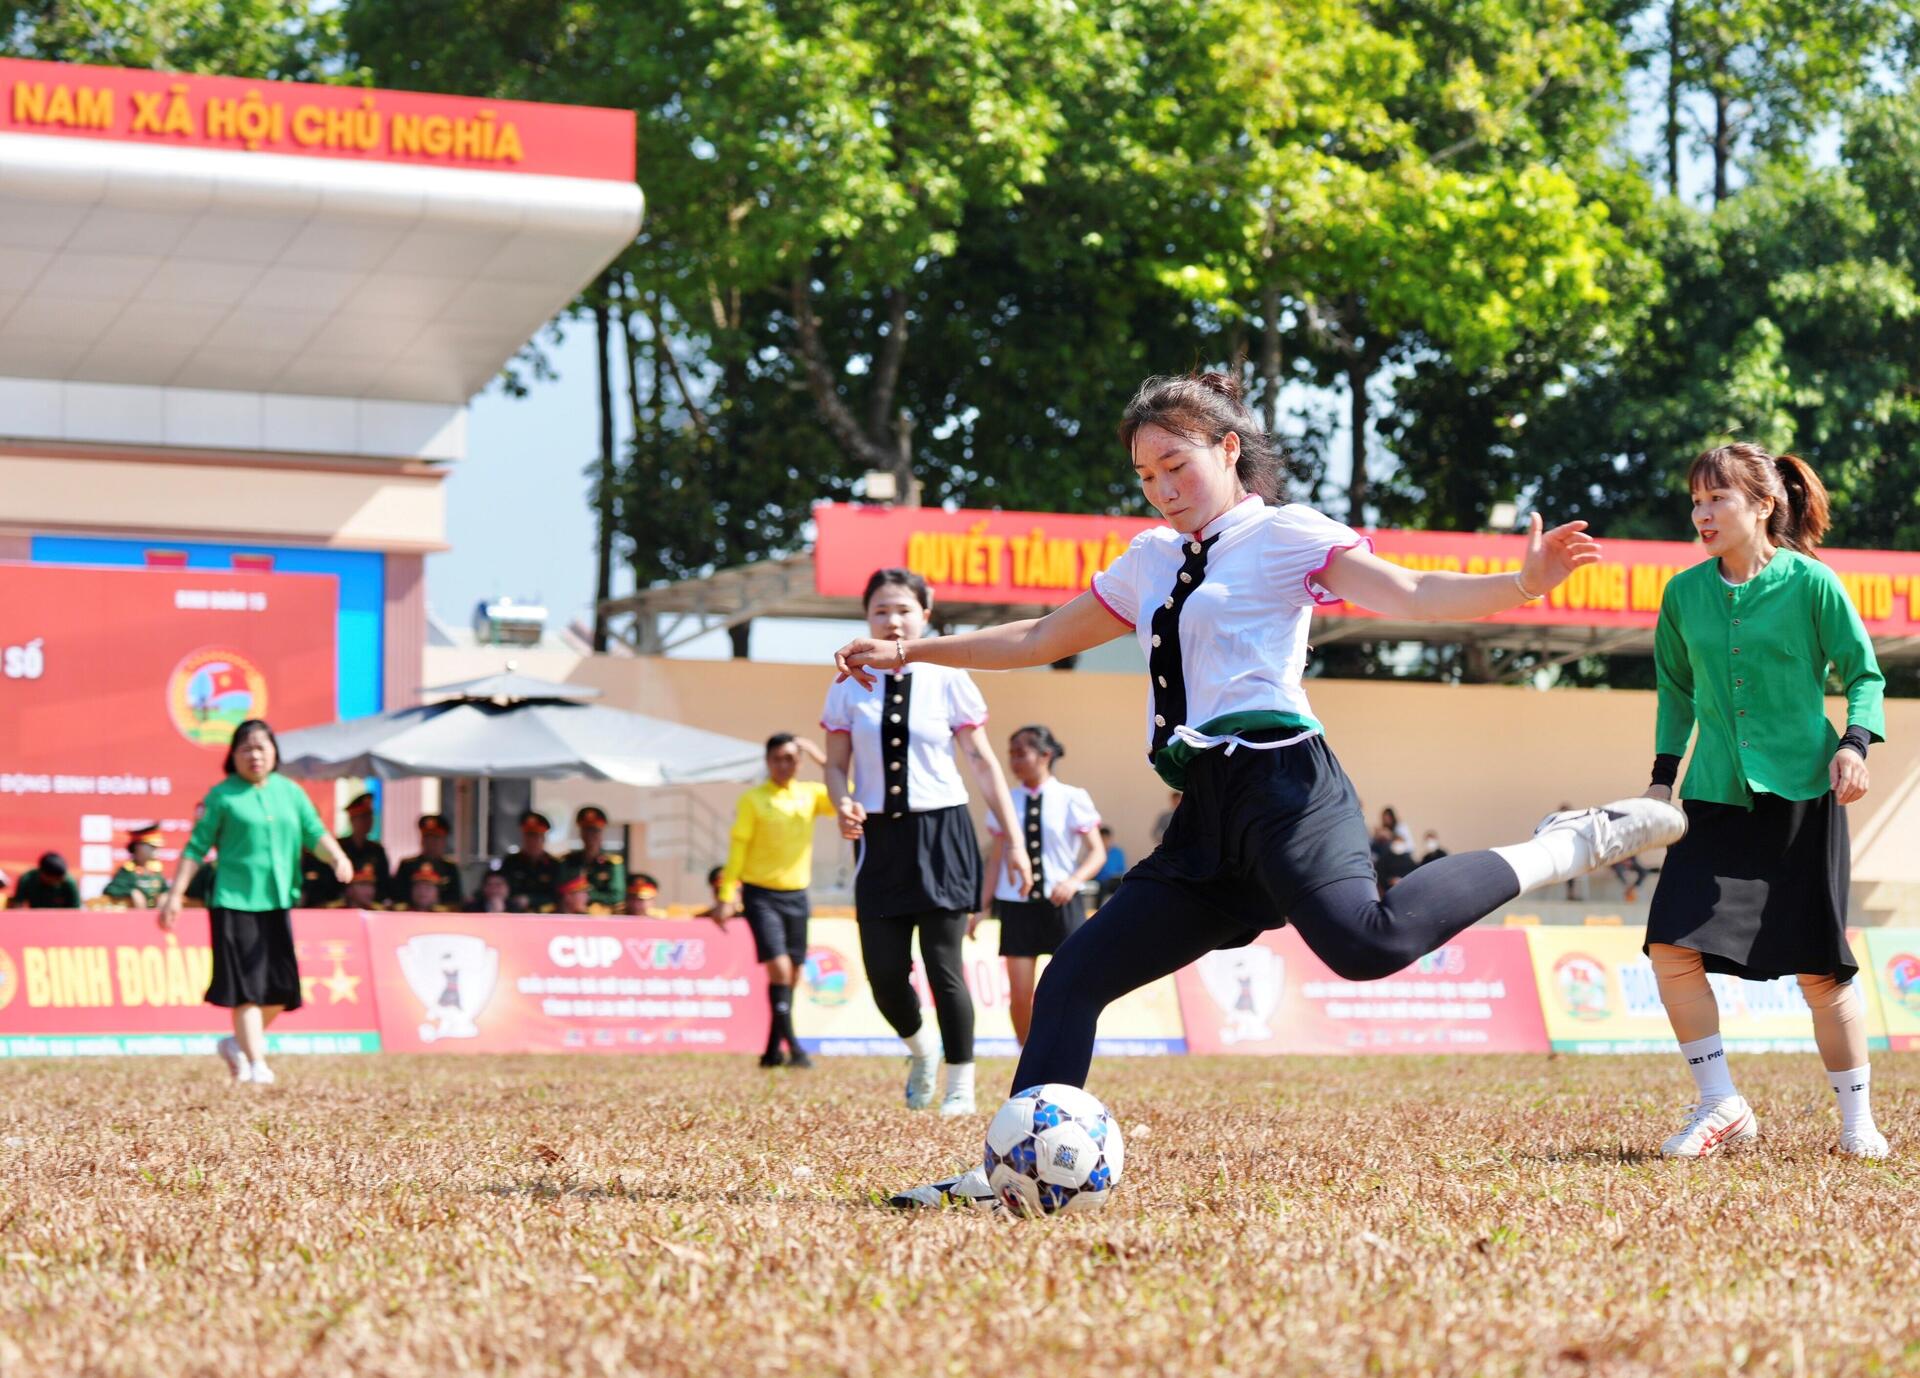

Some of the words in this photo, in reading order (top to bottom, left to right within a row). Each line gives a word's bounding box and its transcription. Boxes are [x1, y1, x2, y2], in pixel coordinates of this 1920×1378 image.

[13, 81, 114, 128] NAM
[131, 83, 195, 135] XÃ
[206, 89, 283, 151] HỘI
[291, 96, 381, 150] CHỦ
[391, 109, 524, 162] NGHĨA
[907, 518, 1003, 585] QUYẾT
[1009, 527, 1076, 589] TÂM
[5, 637, 44, 679] SỐ
[150, 776, 172, 796] 15
[23, 946, 114, 1008] BINH
[548, 935, 623, 968] CUP
